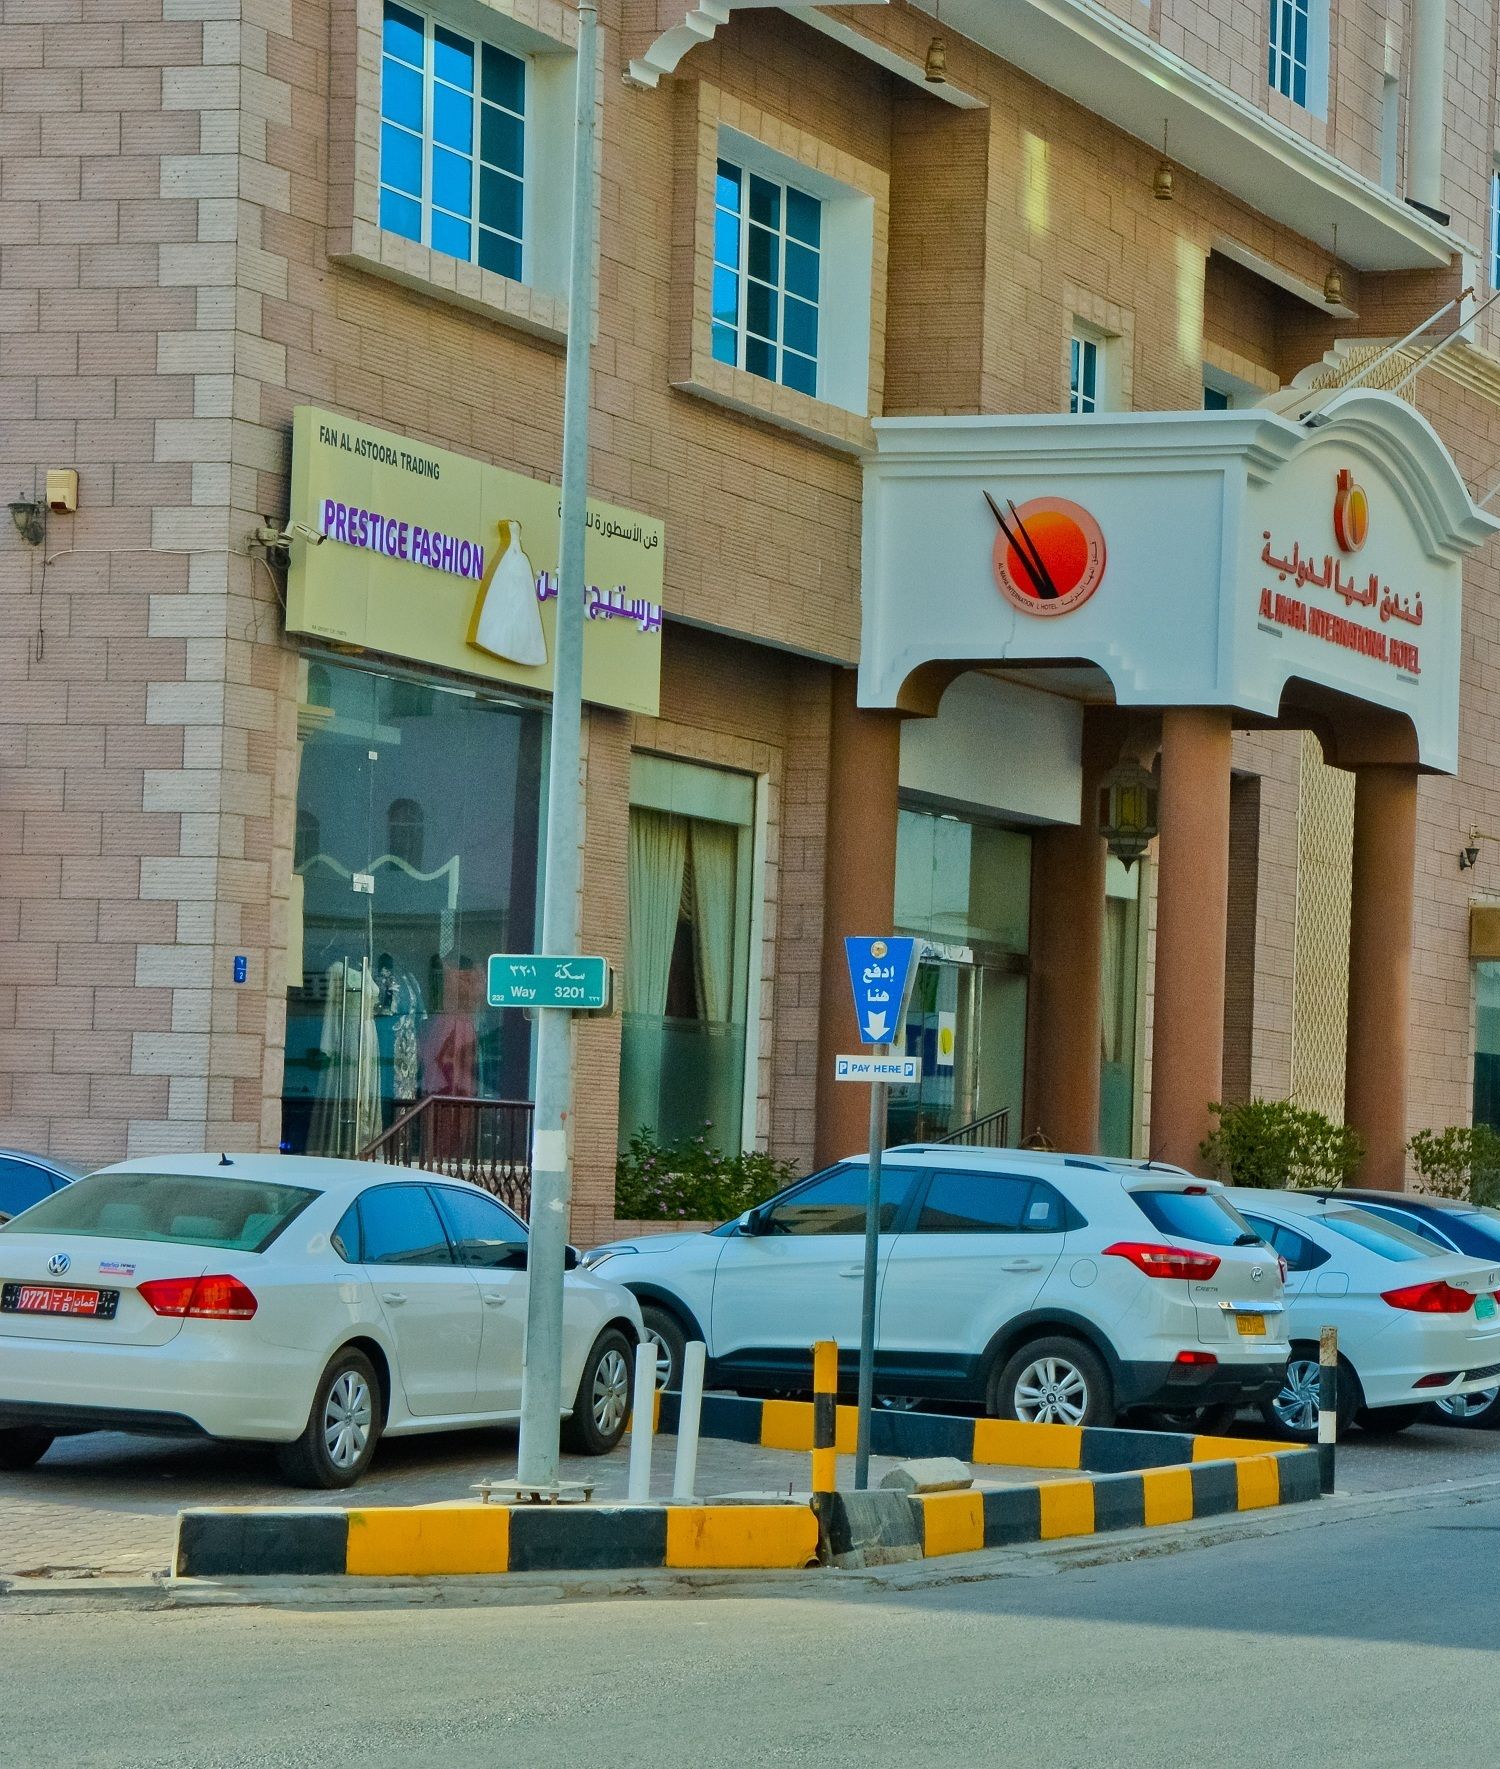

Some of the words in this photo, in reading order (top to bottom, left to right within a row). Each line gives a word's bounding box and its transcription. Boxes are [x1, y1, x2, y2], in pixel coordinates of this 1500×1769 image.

[319, 425, 338, 447] FAN
[340, 432, 352, 452] AL
[354, 437, 398, 467] ASTOORA
[400, 452, 440, 480] TRADING
[324, 498, 409, 559] PRESTIGE
[411, 525, 484, 581] FASHION
[594, 513, 642, 543] الأسطورة
[643, 530, 659, 550] فن
[1261, 530, 1333, 588] الدولية
[1334, 559, 1379, 608] المها
[589, 585, 662, 632] برستيج
[1379, 585, 1424, 626] فندق
[1259, 587, 1275, 619] AL
[1275, 593, 1308, 632] MAHA
[1308, 606, 1388, 662] INTERNATIONAL
[1389, 637, 1422, 675] HOTEL
[509, 964, 537, 977] ٣٢٠١
[554, 962, 586, 980] سكة
[862, 963, 895, 984] إدفع
[510, 985, 537, 1000] Way
[554, 986, 585, 999] 3201
[867, 988, 890, 1002] هنا
[851, 1063, 871, 1073] PAY
[873, 1064, 902, 1074] HERE
[21, 1289, 50, 1310] 9771
